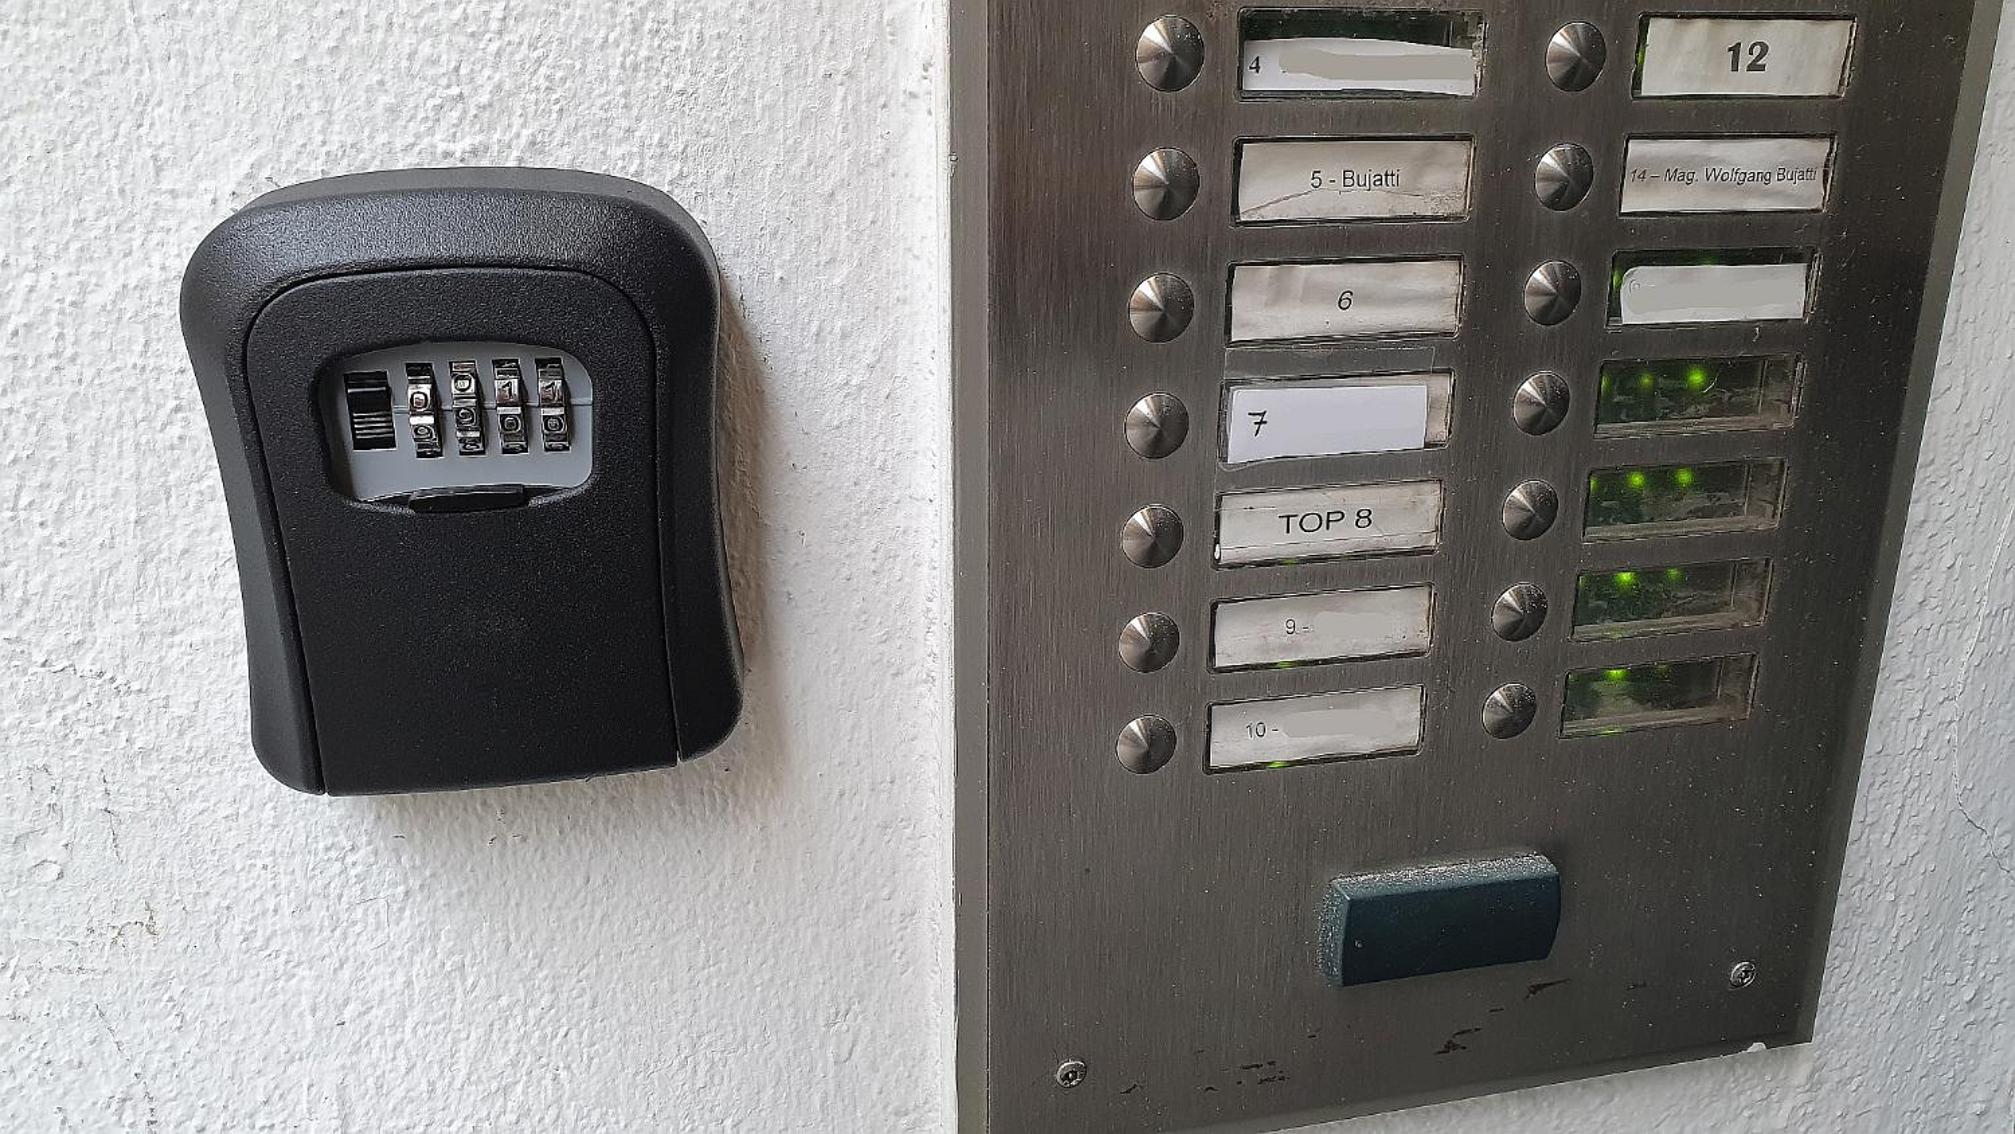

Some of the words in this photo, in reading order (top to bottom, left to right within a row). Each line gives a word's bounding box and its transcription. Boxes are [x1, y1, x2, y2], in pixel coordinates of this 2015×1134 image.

[1248, 55, 1261, 74] 4
[1727, 41, 1770, 73] 12
[1310, 170, 1323, 189] 5
[1342, 168, 1400, 191] Bujatti
[1630, 168, 1648, 183] 14
[1664, 167, 1699, 186] Mag.
[1704, 167, 1772, 186] Wolfgang
[1776, 166, 1818, 185] Bujatti
[1337, 290, 1353, 311] 6
[1247, 410, 1269, 438] 7
[1278, 510, 1346, 534] TOP
[1354, 507, 1373, 529] 8
[1286, 618, 1296, 635] 9
[1246, 721, 1266, 738] 10
